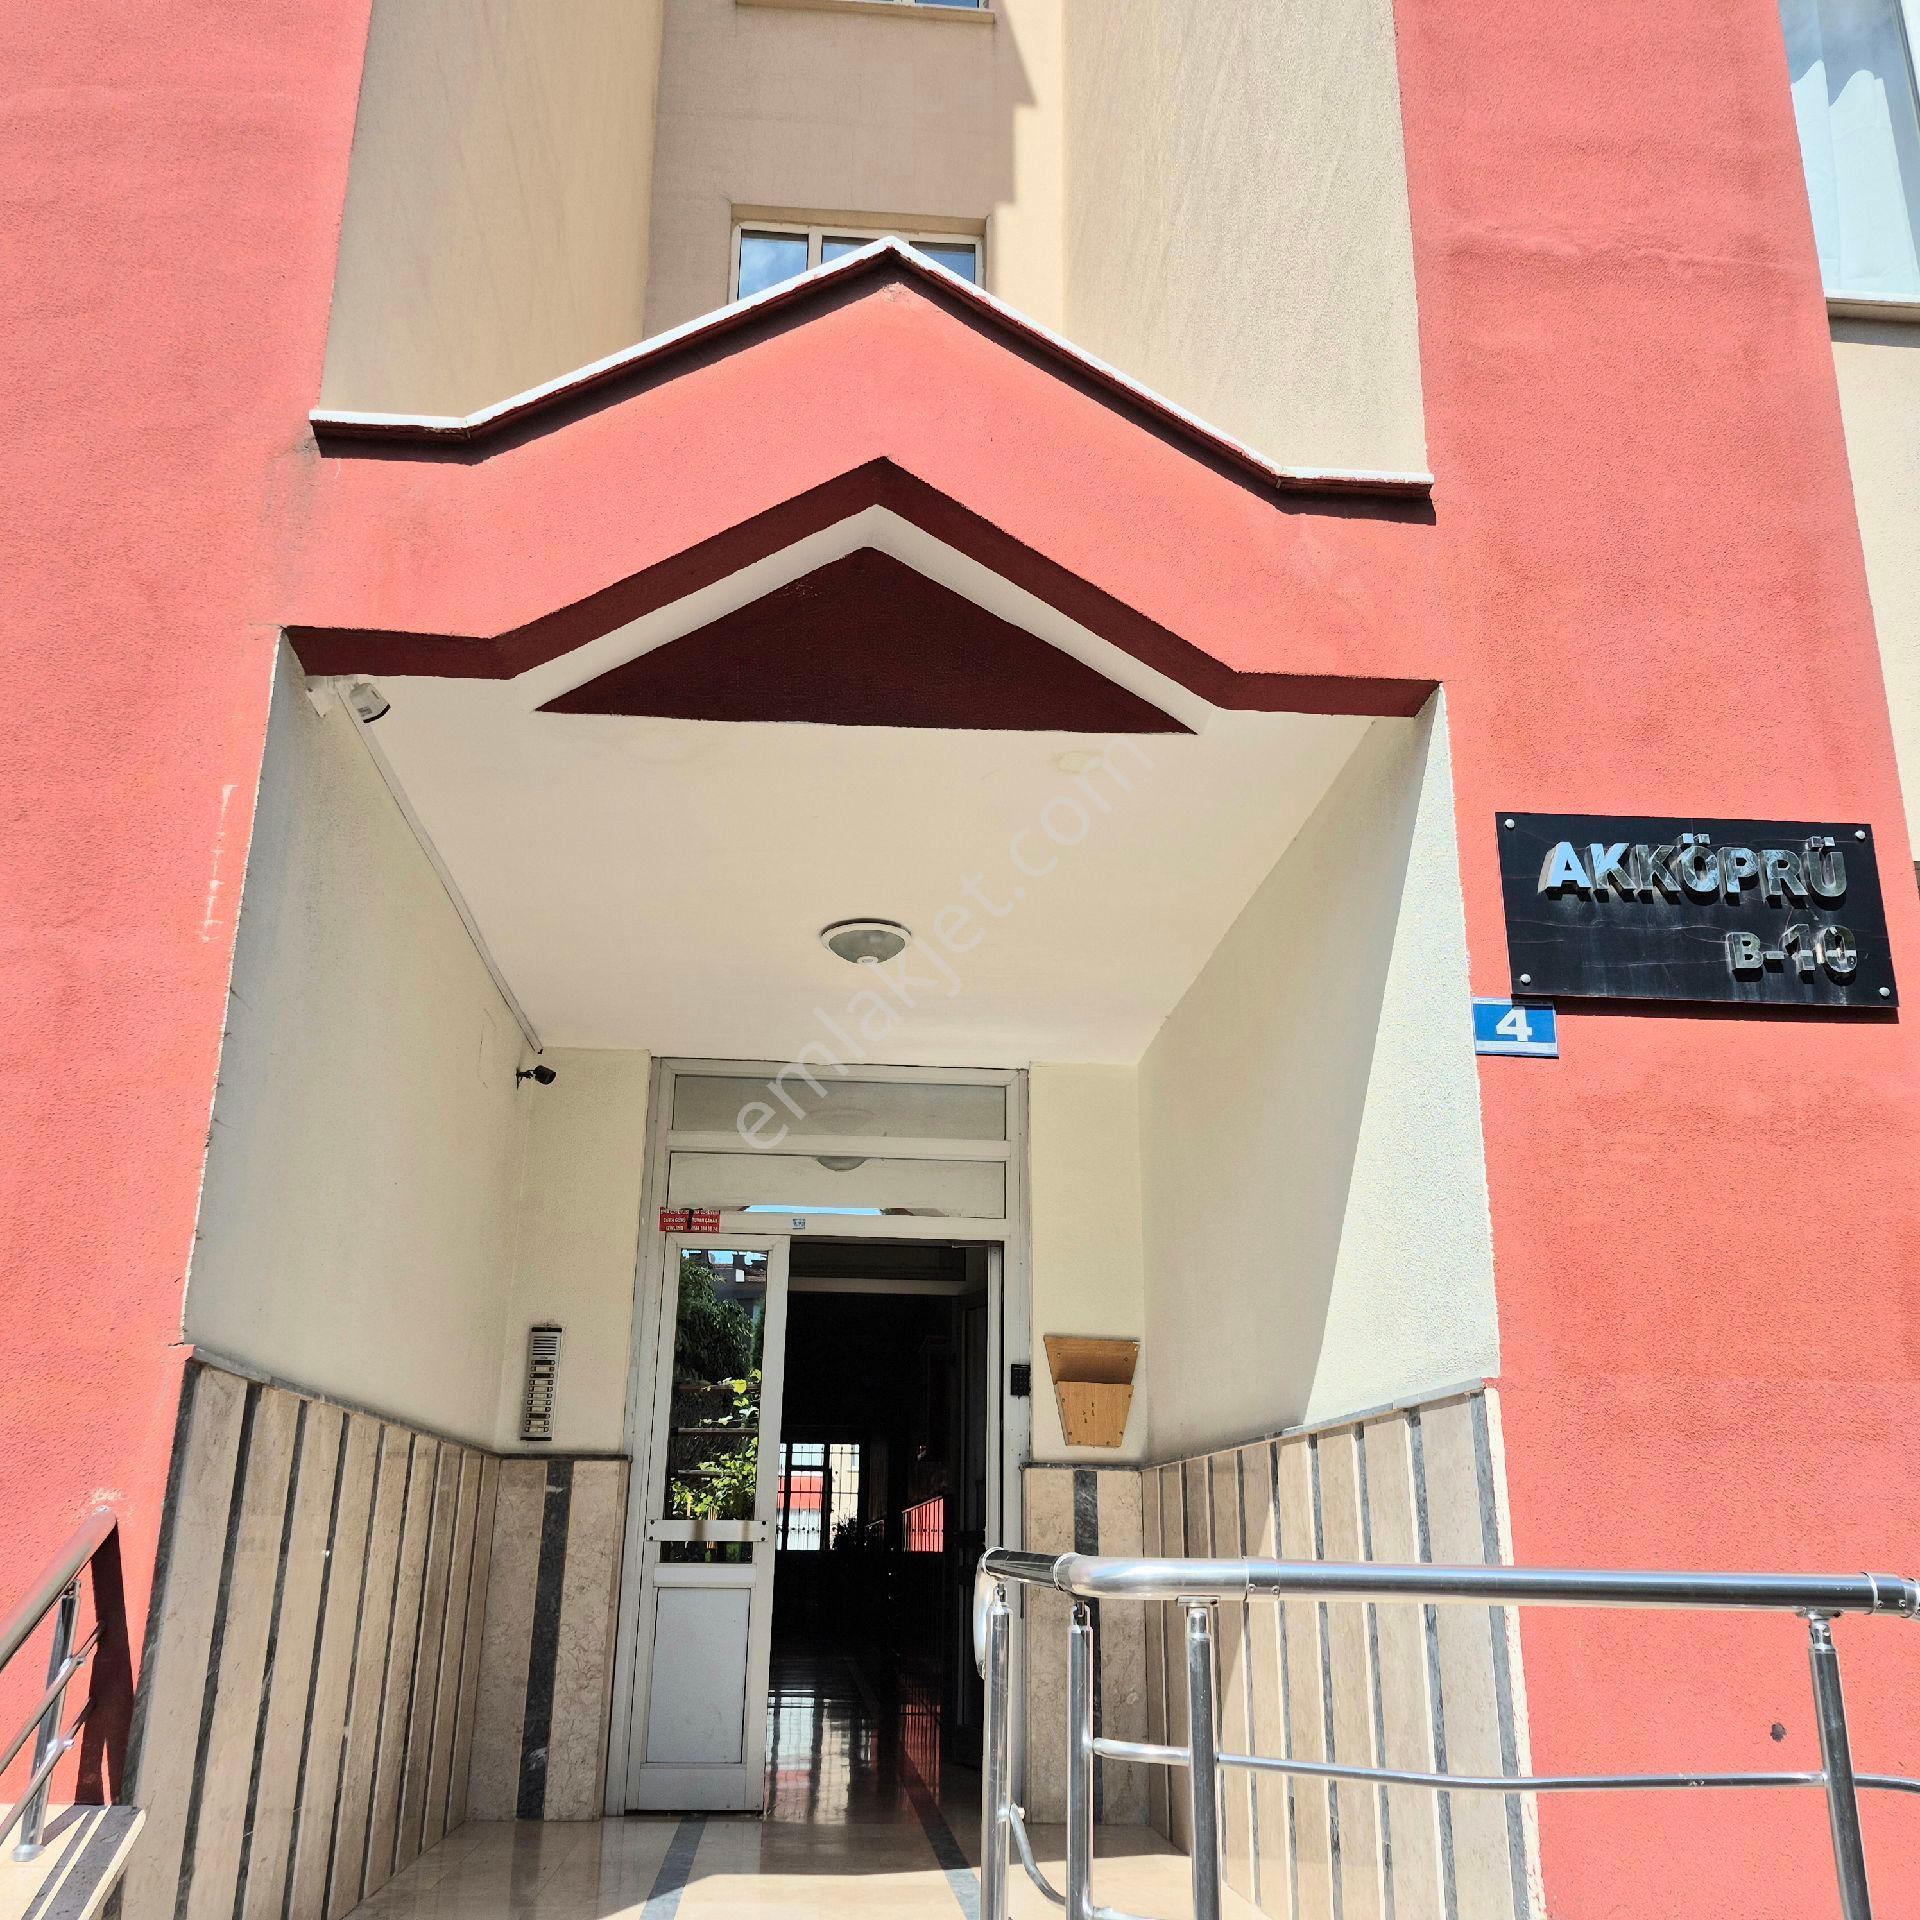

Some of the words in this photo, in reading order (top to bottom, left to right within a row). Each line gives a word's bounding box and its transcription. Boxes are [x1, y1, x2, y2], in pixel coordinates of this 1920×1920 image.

[1540, 833, 1848, 898] AKKÖPRÜ
[1727, 923, 1857, 973] B-10
[1496, 1006, 1532, 1041] 4
